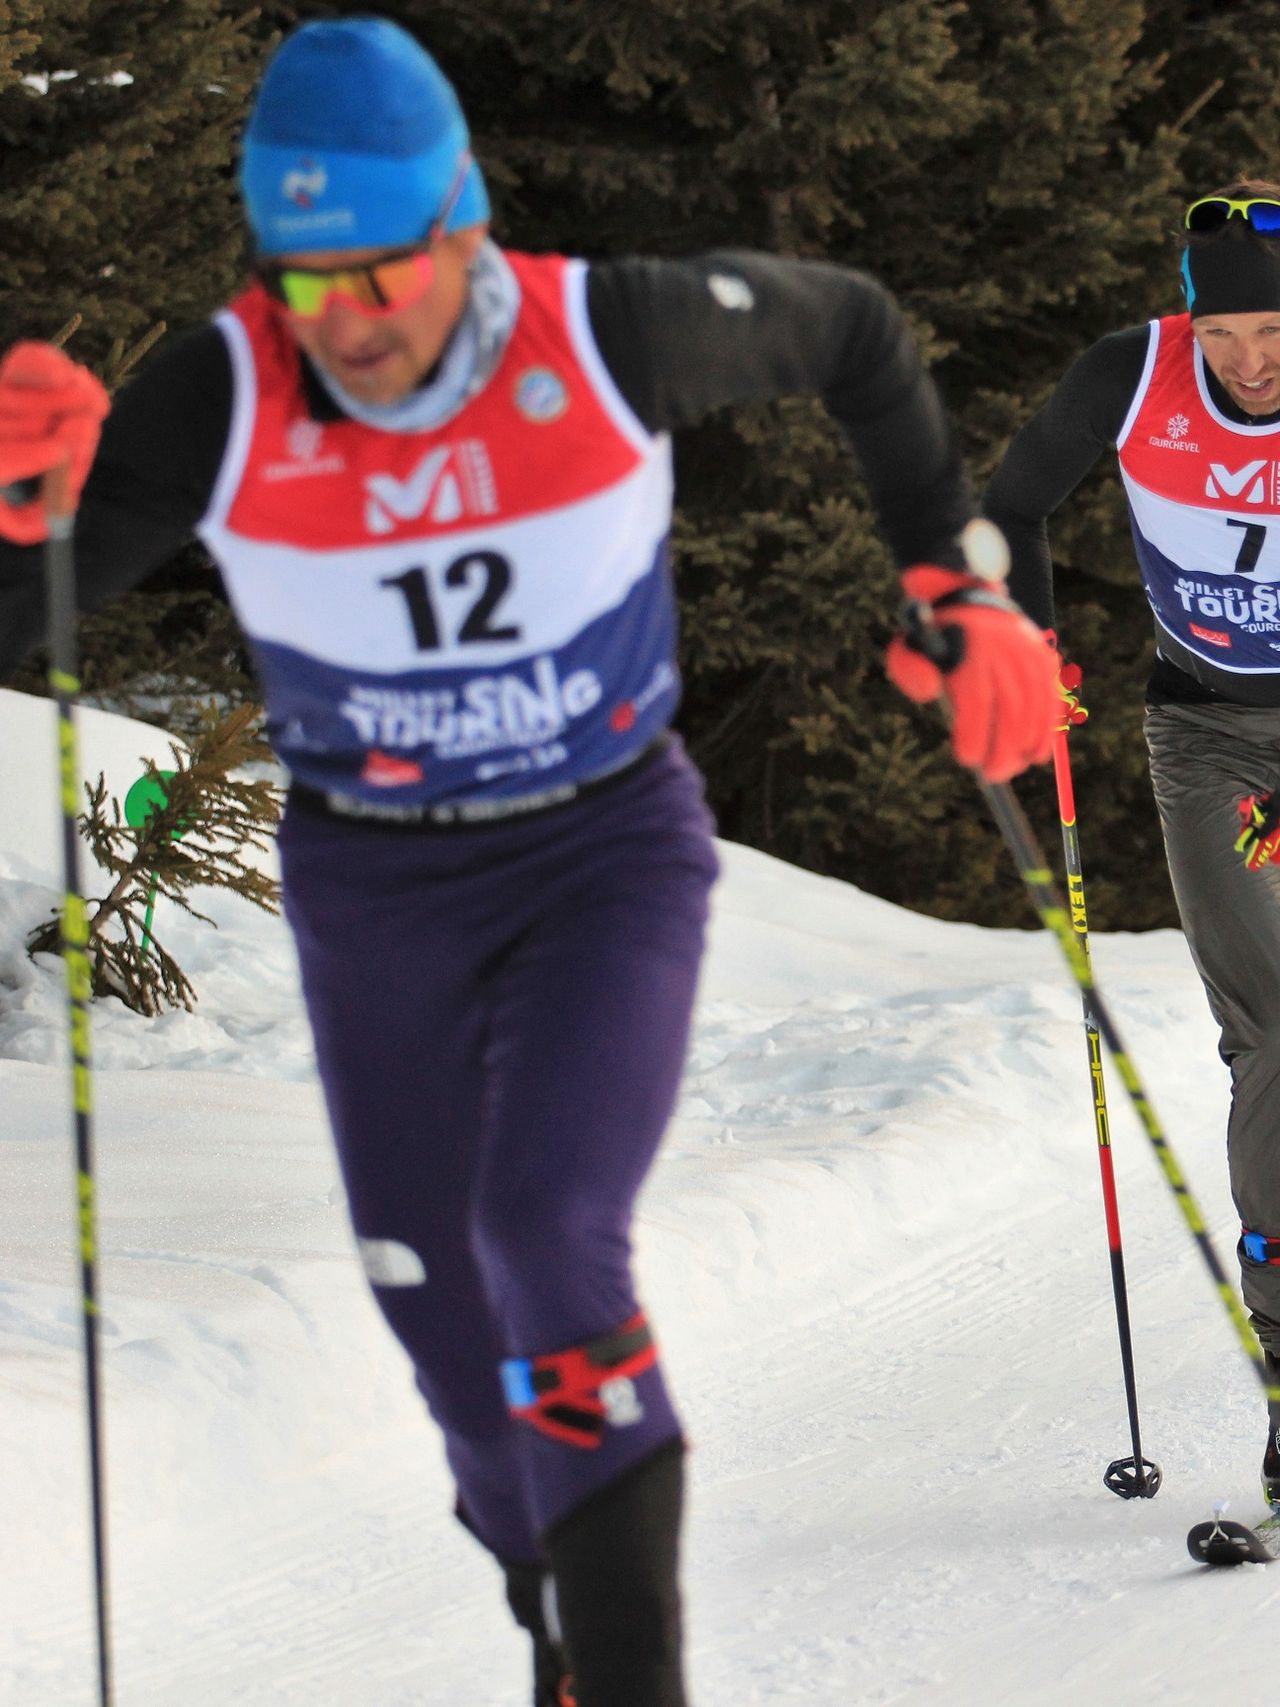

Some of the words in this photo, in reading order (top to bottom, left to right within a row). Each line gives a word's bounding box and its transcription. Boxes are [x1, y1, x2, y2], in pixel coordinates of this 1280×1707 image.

[1149, 436, 1200, 453] COURCHEVEL
[1226, 518, 1267, 574] 7
[380, 550, 523, 654] 12
[1068, 874, 1088, 933] LEKI
